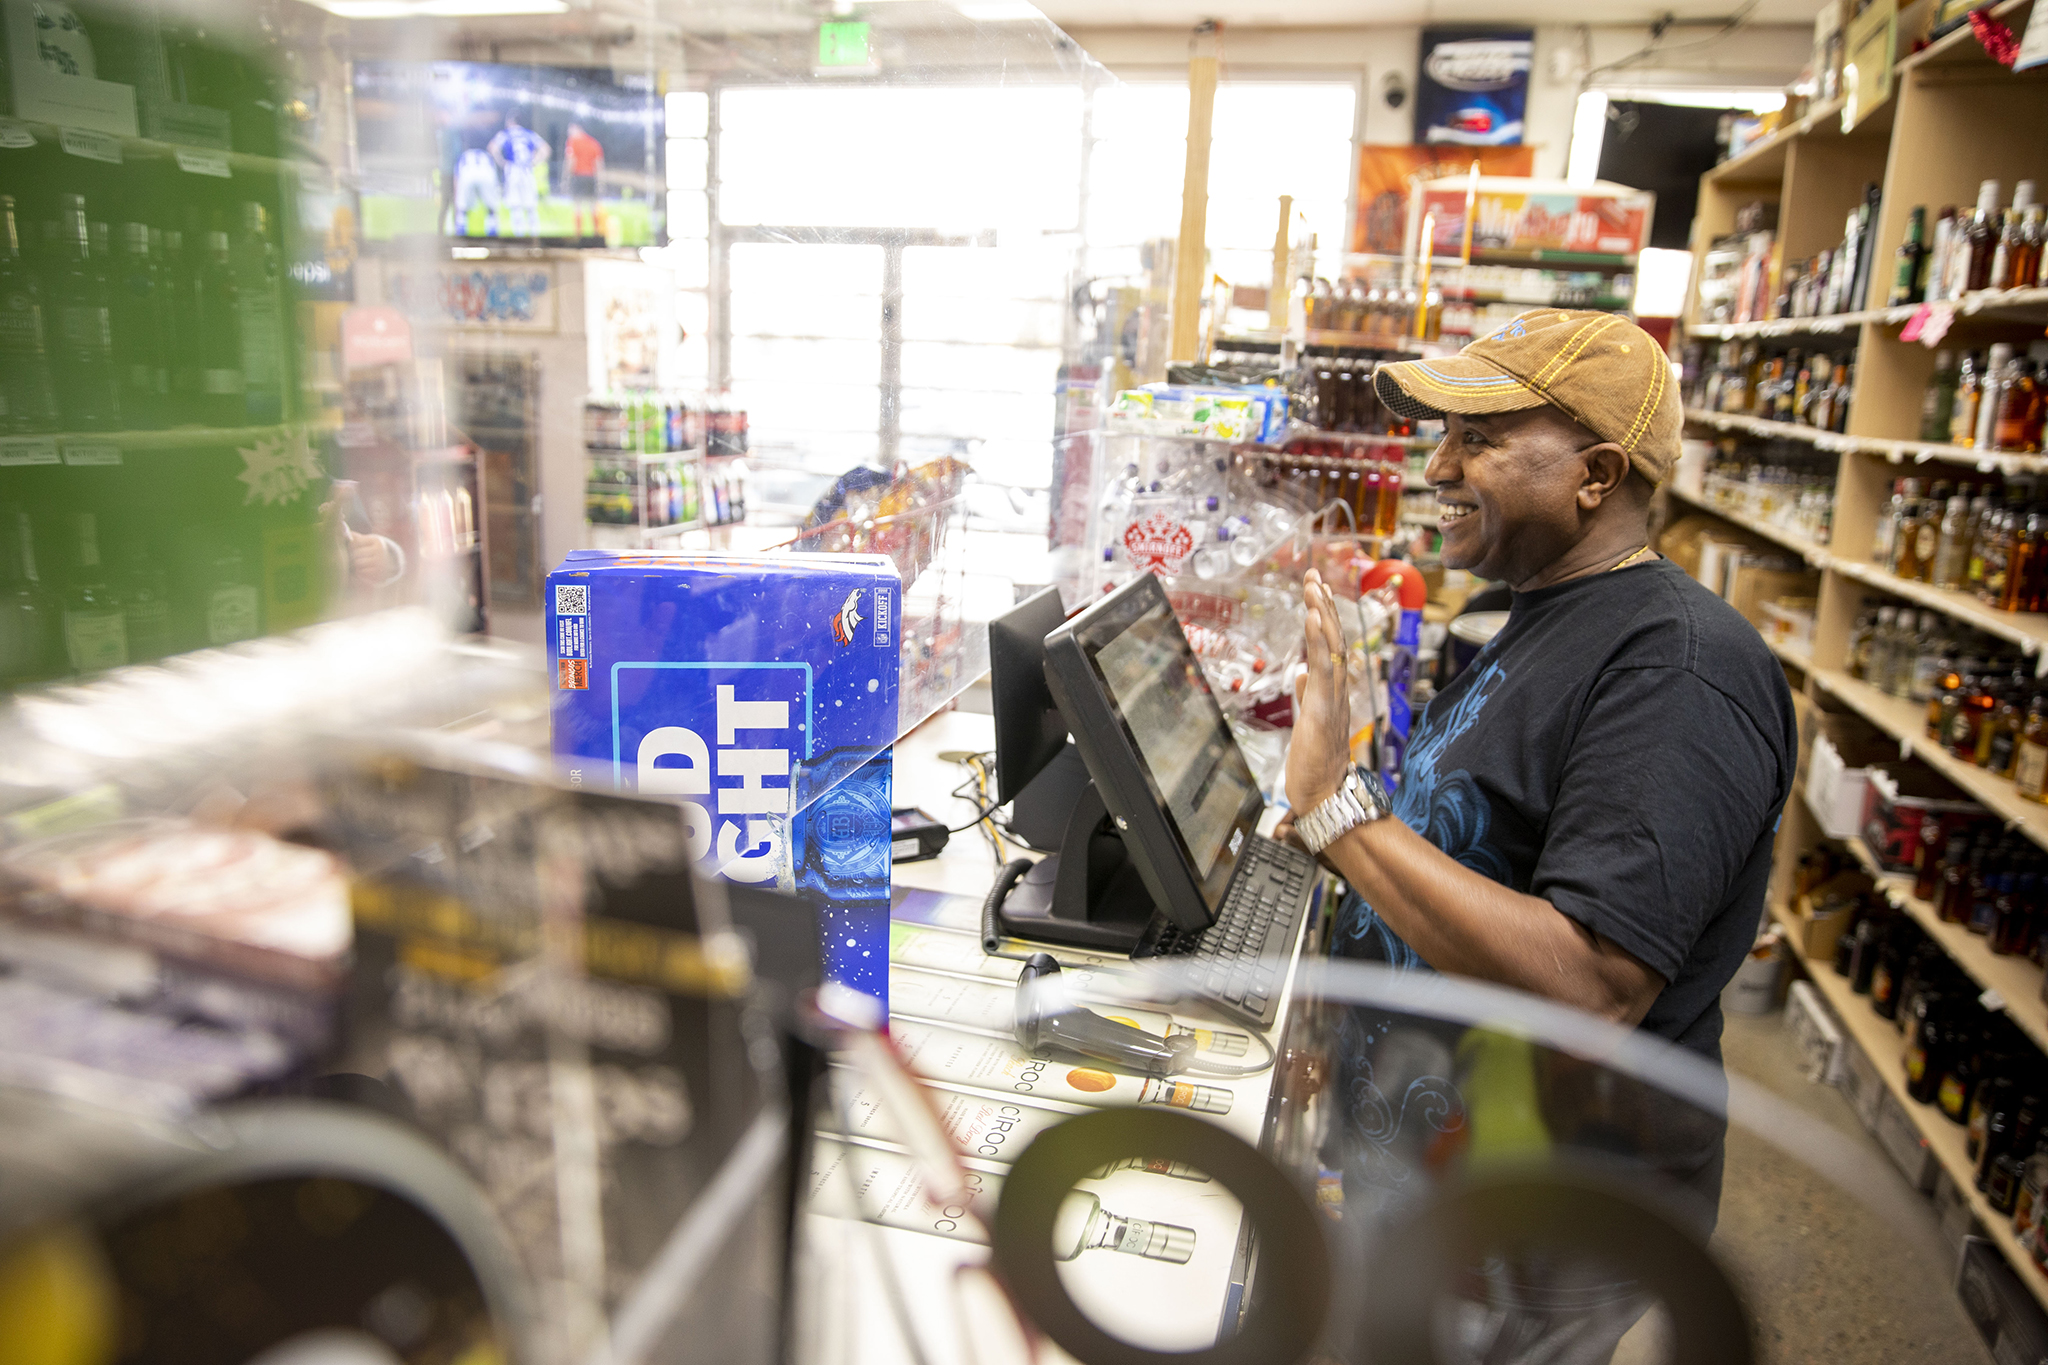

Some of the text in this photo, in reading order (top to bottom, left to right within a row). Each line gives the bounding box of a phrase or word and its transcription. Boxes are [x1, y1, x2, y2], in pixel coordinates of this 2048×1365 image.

[878, 595, 888, 629] KICKOFF
[568, 660, 576, 689] BRONCOS
[574, 661, 583, 686] MERCH
[1000, 1054, 1026, 1078] Peach
[860, 1099, 870, 1108] 5
[957, 1104, 994, 1146] Red Berry
[978, 1106, 1021, 1155] CÎROC
